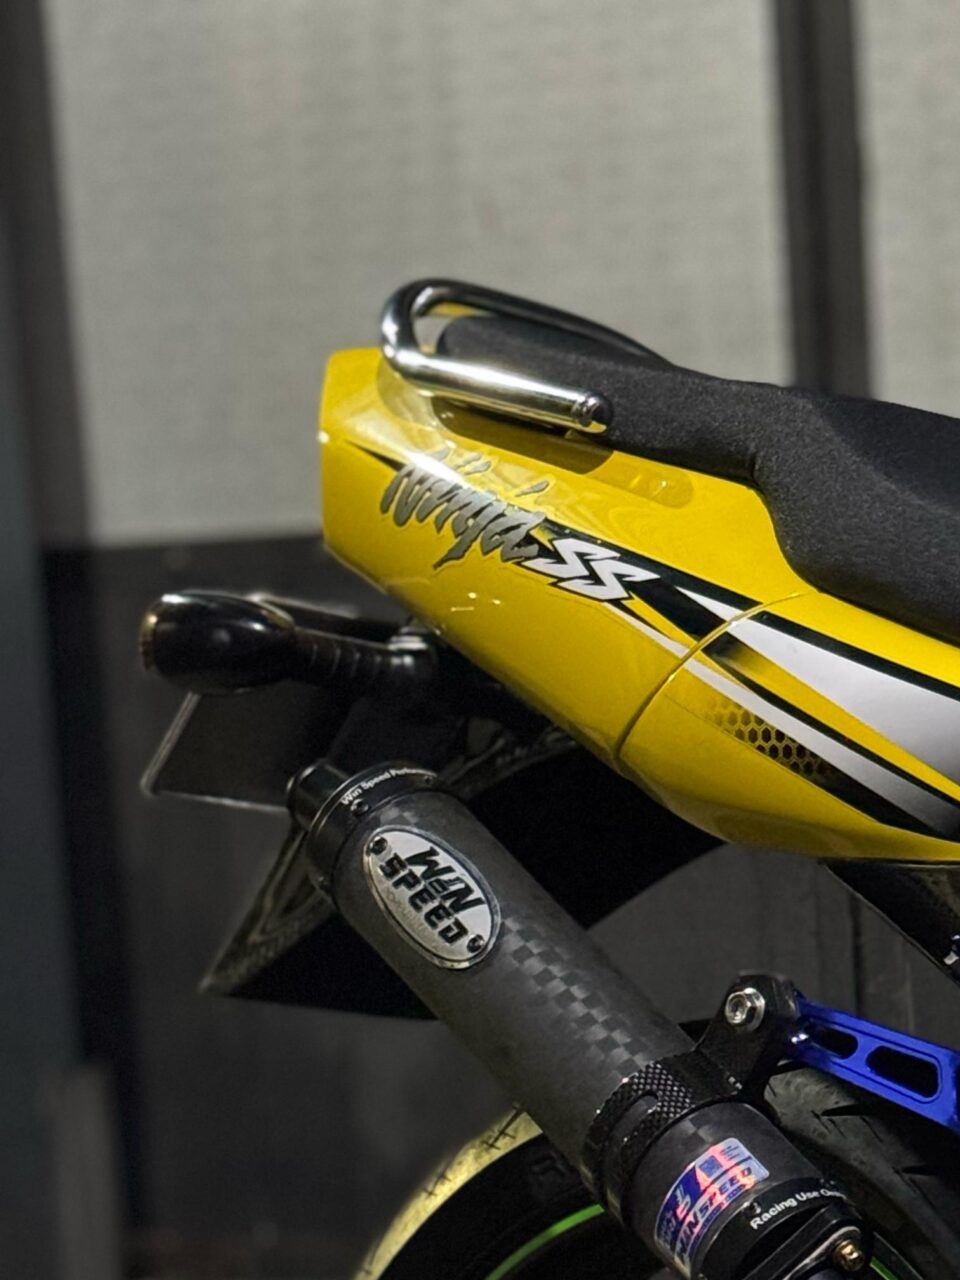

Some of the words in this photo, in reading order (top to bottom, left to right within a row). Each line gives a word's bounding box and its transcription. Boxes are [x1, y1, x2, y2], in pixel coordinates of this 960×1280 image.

[379, 449, 549, 570] Ninja
[518, 536, 662, 602] SS
[340, 787, 363, 805] Win
[379, 852, 469, 944] SPEED
[404, 846, 488, 914] WIN
[749, 1198, 798, 1230] Racing
[794, 1191, 820, 1201] Use
